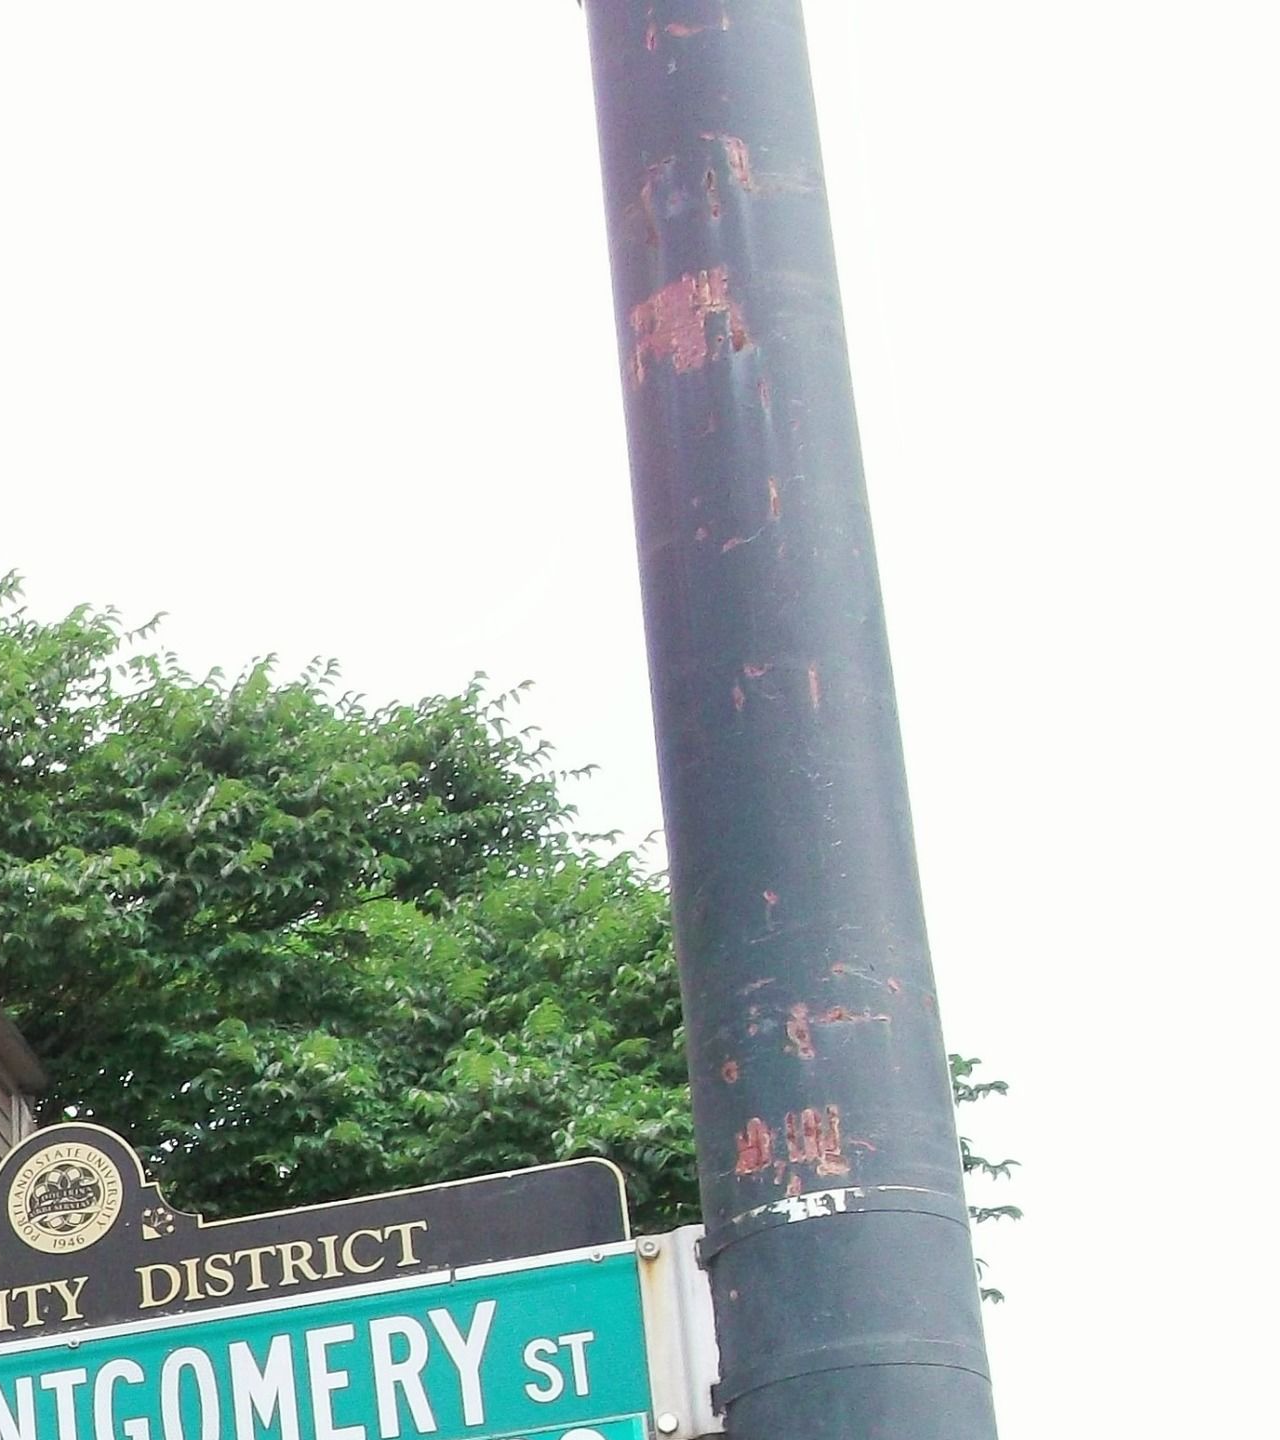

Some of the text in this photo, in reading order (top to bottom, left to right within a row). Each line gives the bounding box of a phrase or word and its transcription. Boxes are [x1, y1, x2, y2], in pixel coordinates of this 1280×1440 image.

[13, 1148, 119, 1242] PORTLAND STATE UNIVERSITY
[52, 1235, 86, 1249] 1946
[136, 1220, 428, 1308] DISTRICT
[524, 1329, 594, 1405] ST
